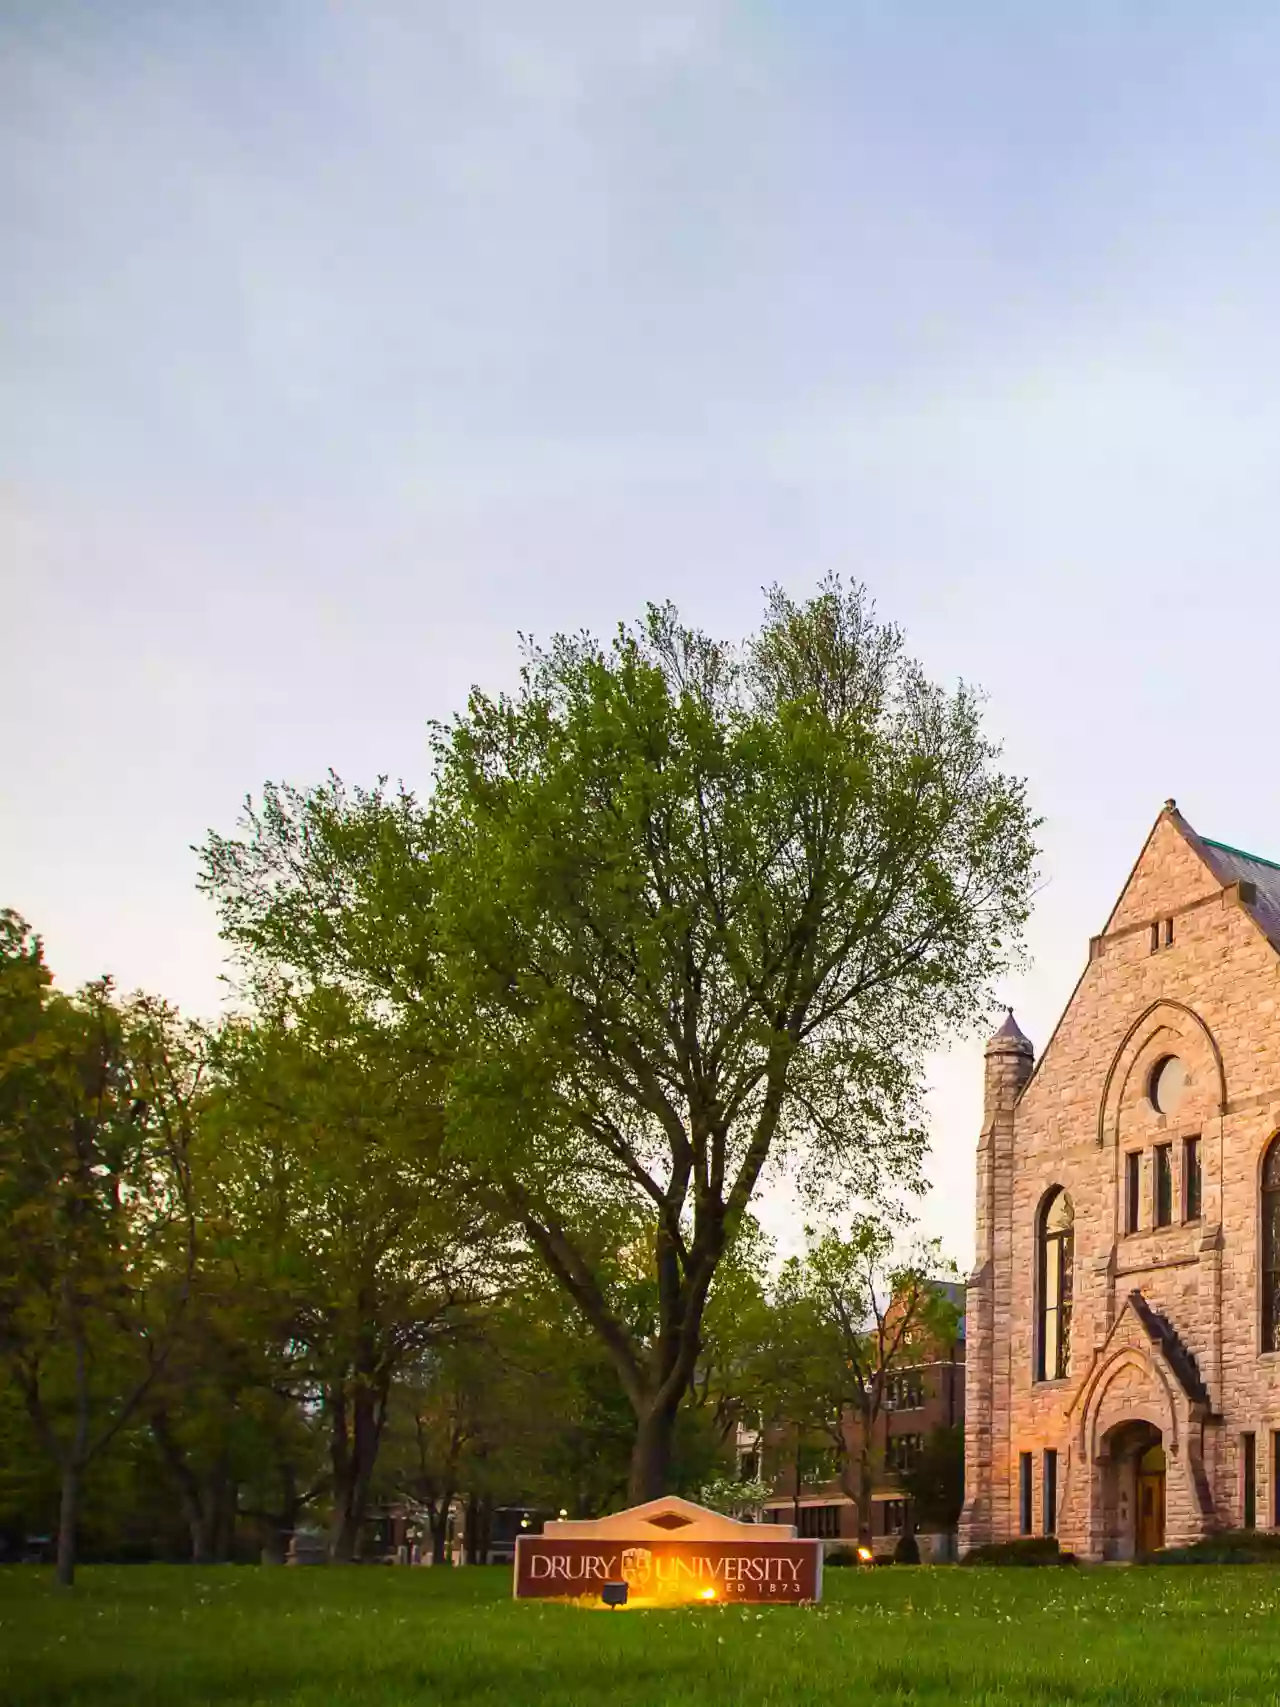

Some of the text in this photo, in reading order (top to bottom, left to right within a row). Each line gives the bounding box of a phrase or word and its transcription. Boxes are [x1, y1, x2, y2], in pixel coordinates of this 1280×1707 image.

[530, 1554, 804, 1581] DRURY UNIVERSITY
[656, 1582, 801, 1593] FOED 1873
